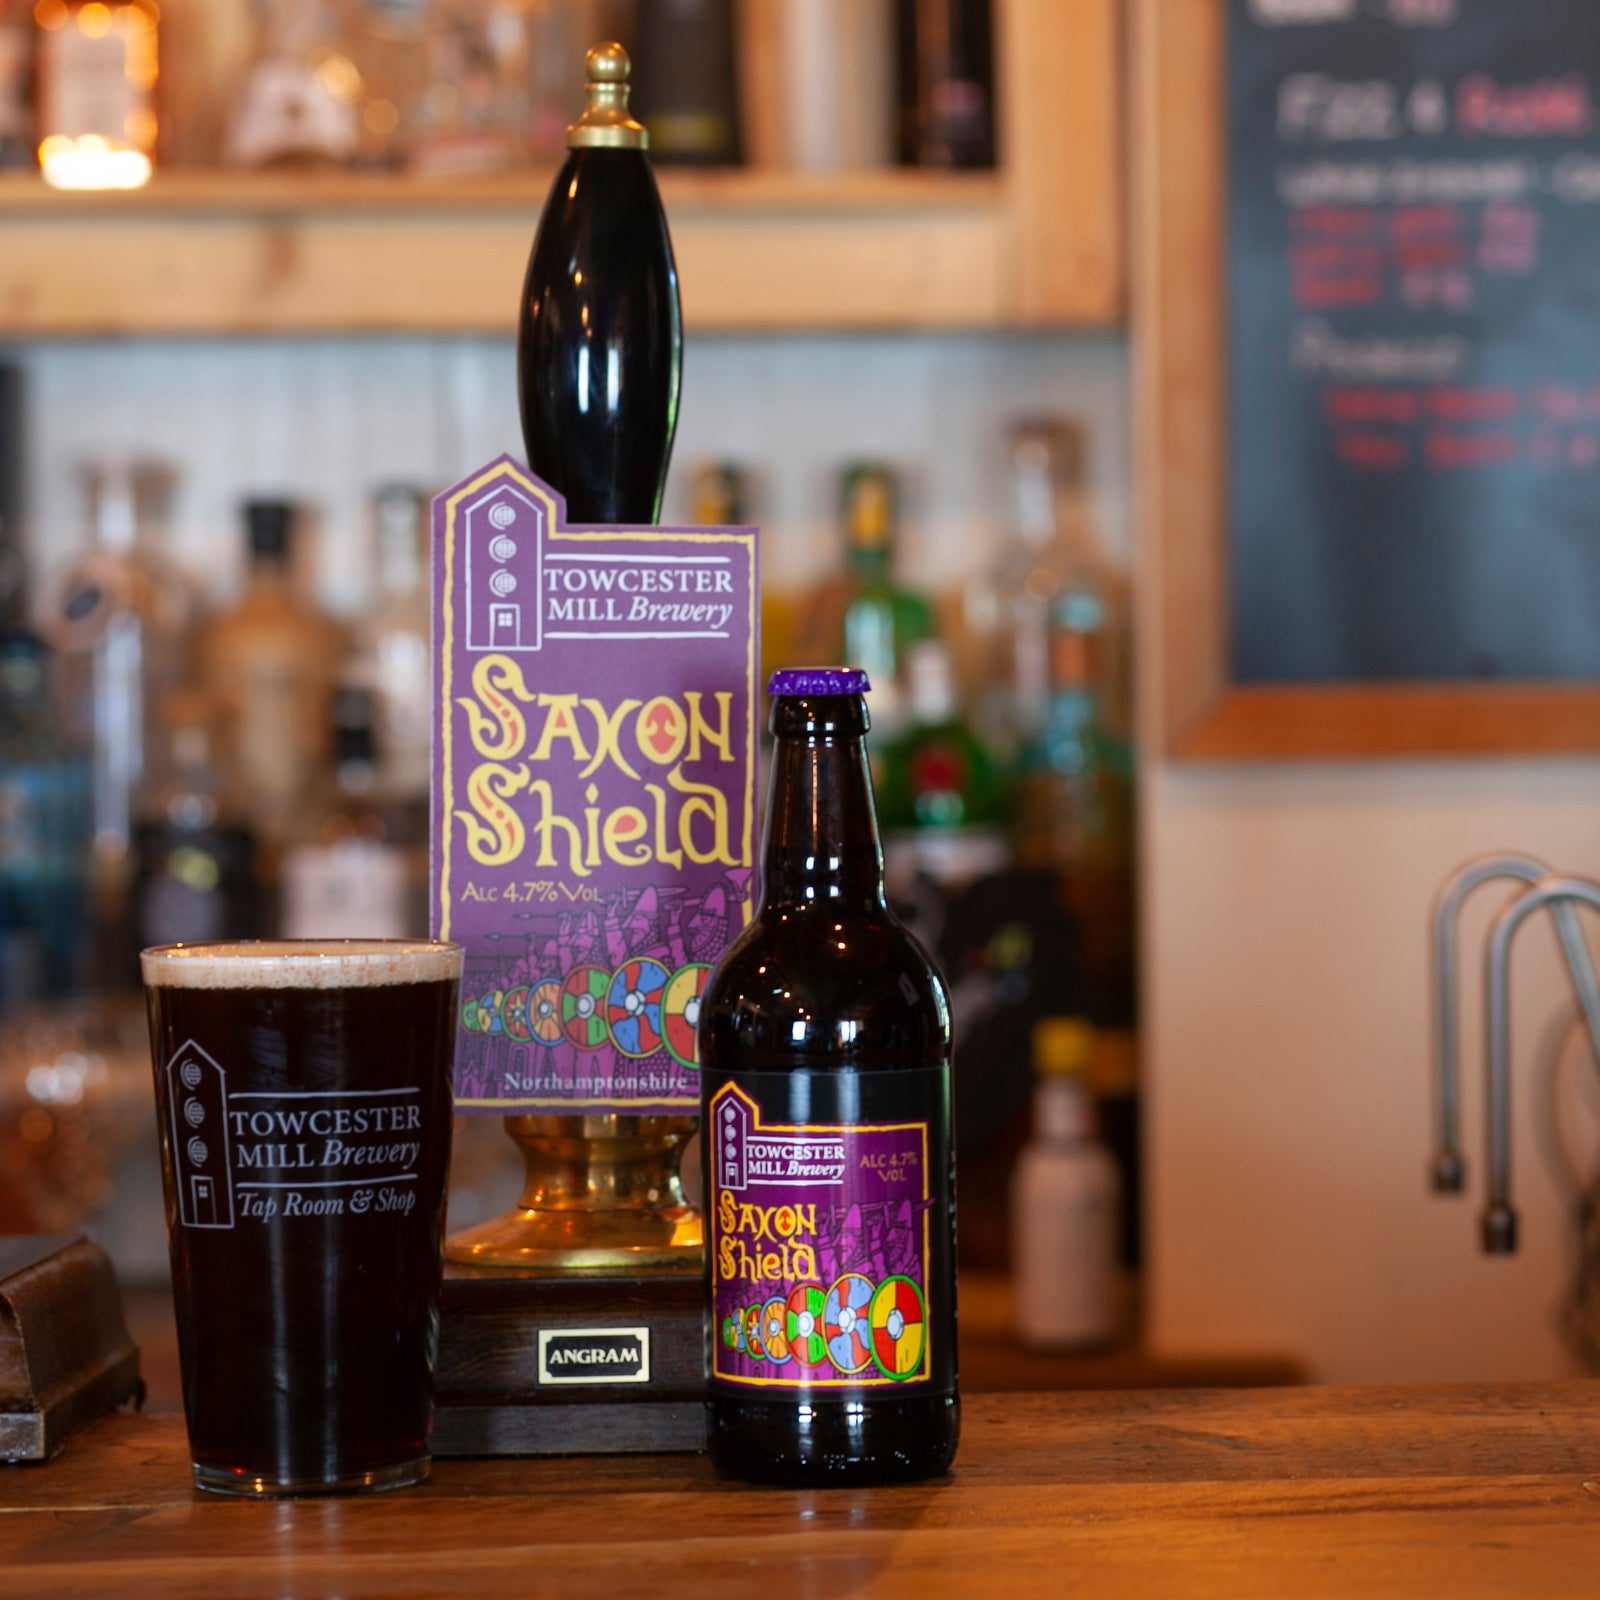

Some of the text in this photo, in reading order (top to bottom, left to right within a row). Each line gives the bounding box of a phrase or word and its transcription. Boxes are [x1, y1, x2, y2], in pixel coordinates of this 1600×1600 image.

[543, 568, 734, 593] TOWCESTER
[547, 597, 733, 630] MILL Brewery
[453, 761, 743, 878] Shield
[502, 880, 558, 904] 4.7%
[503, 1072, 688, 1095] Northamptonshire
[229, 1105, 421, 1136] TOWCESTER
[236, 1138, 420, 1170] MILL Brewery
[746, 1144, 846, 1160] TOWCESTER
[888, 1151, 918, 1166] 4.7%
[748, 1160, 846, 1180] MILL Brewery
[237, 1187, 417, 1223] Tap Room & Shop
[717, 1234, 821, 1283] Shield
[549, 1347, 640, 1365] ANGRAM
